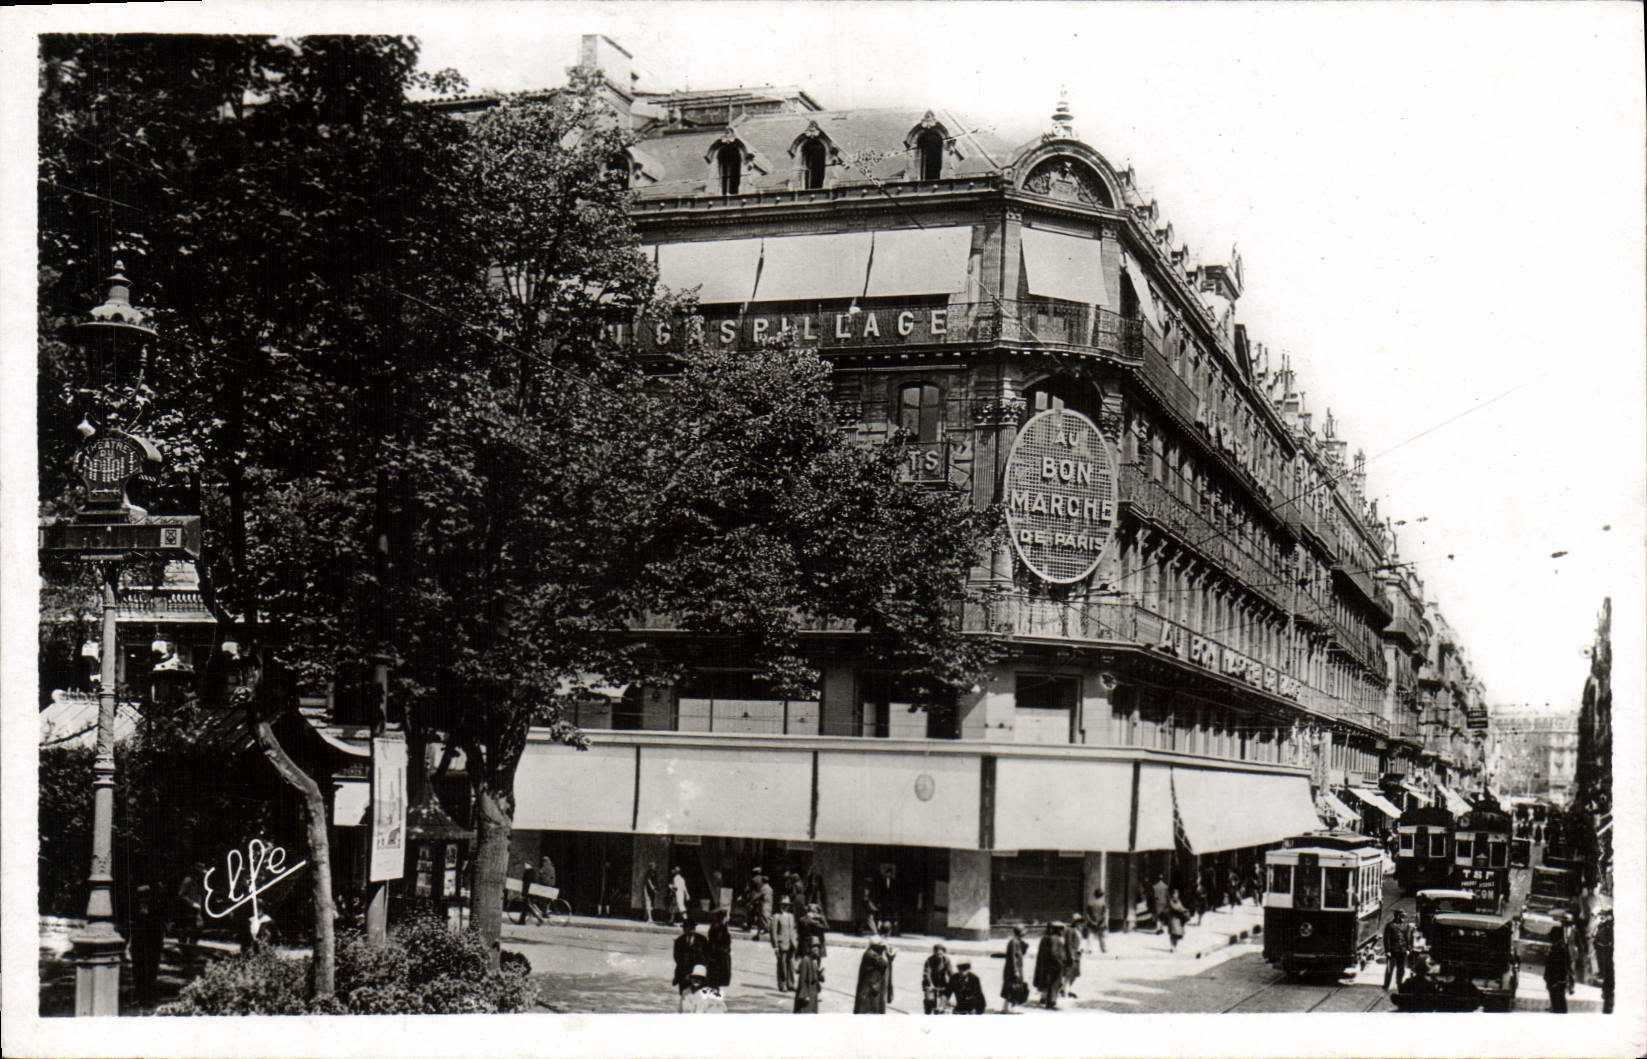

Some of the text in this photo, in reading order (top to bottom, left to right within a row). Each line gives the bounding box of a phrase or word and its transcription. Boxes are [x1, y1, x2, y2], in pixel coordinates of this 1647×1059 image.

[1055, 430, 1080, 447] AU
[1042, 456, 1091, 484] BON
[1010, 490, 1113, 521] MARCHE
[1020, 529, 1104, 551] DE PARIS
[1159, 621, 1184, 655] AU
